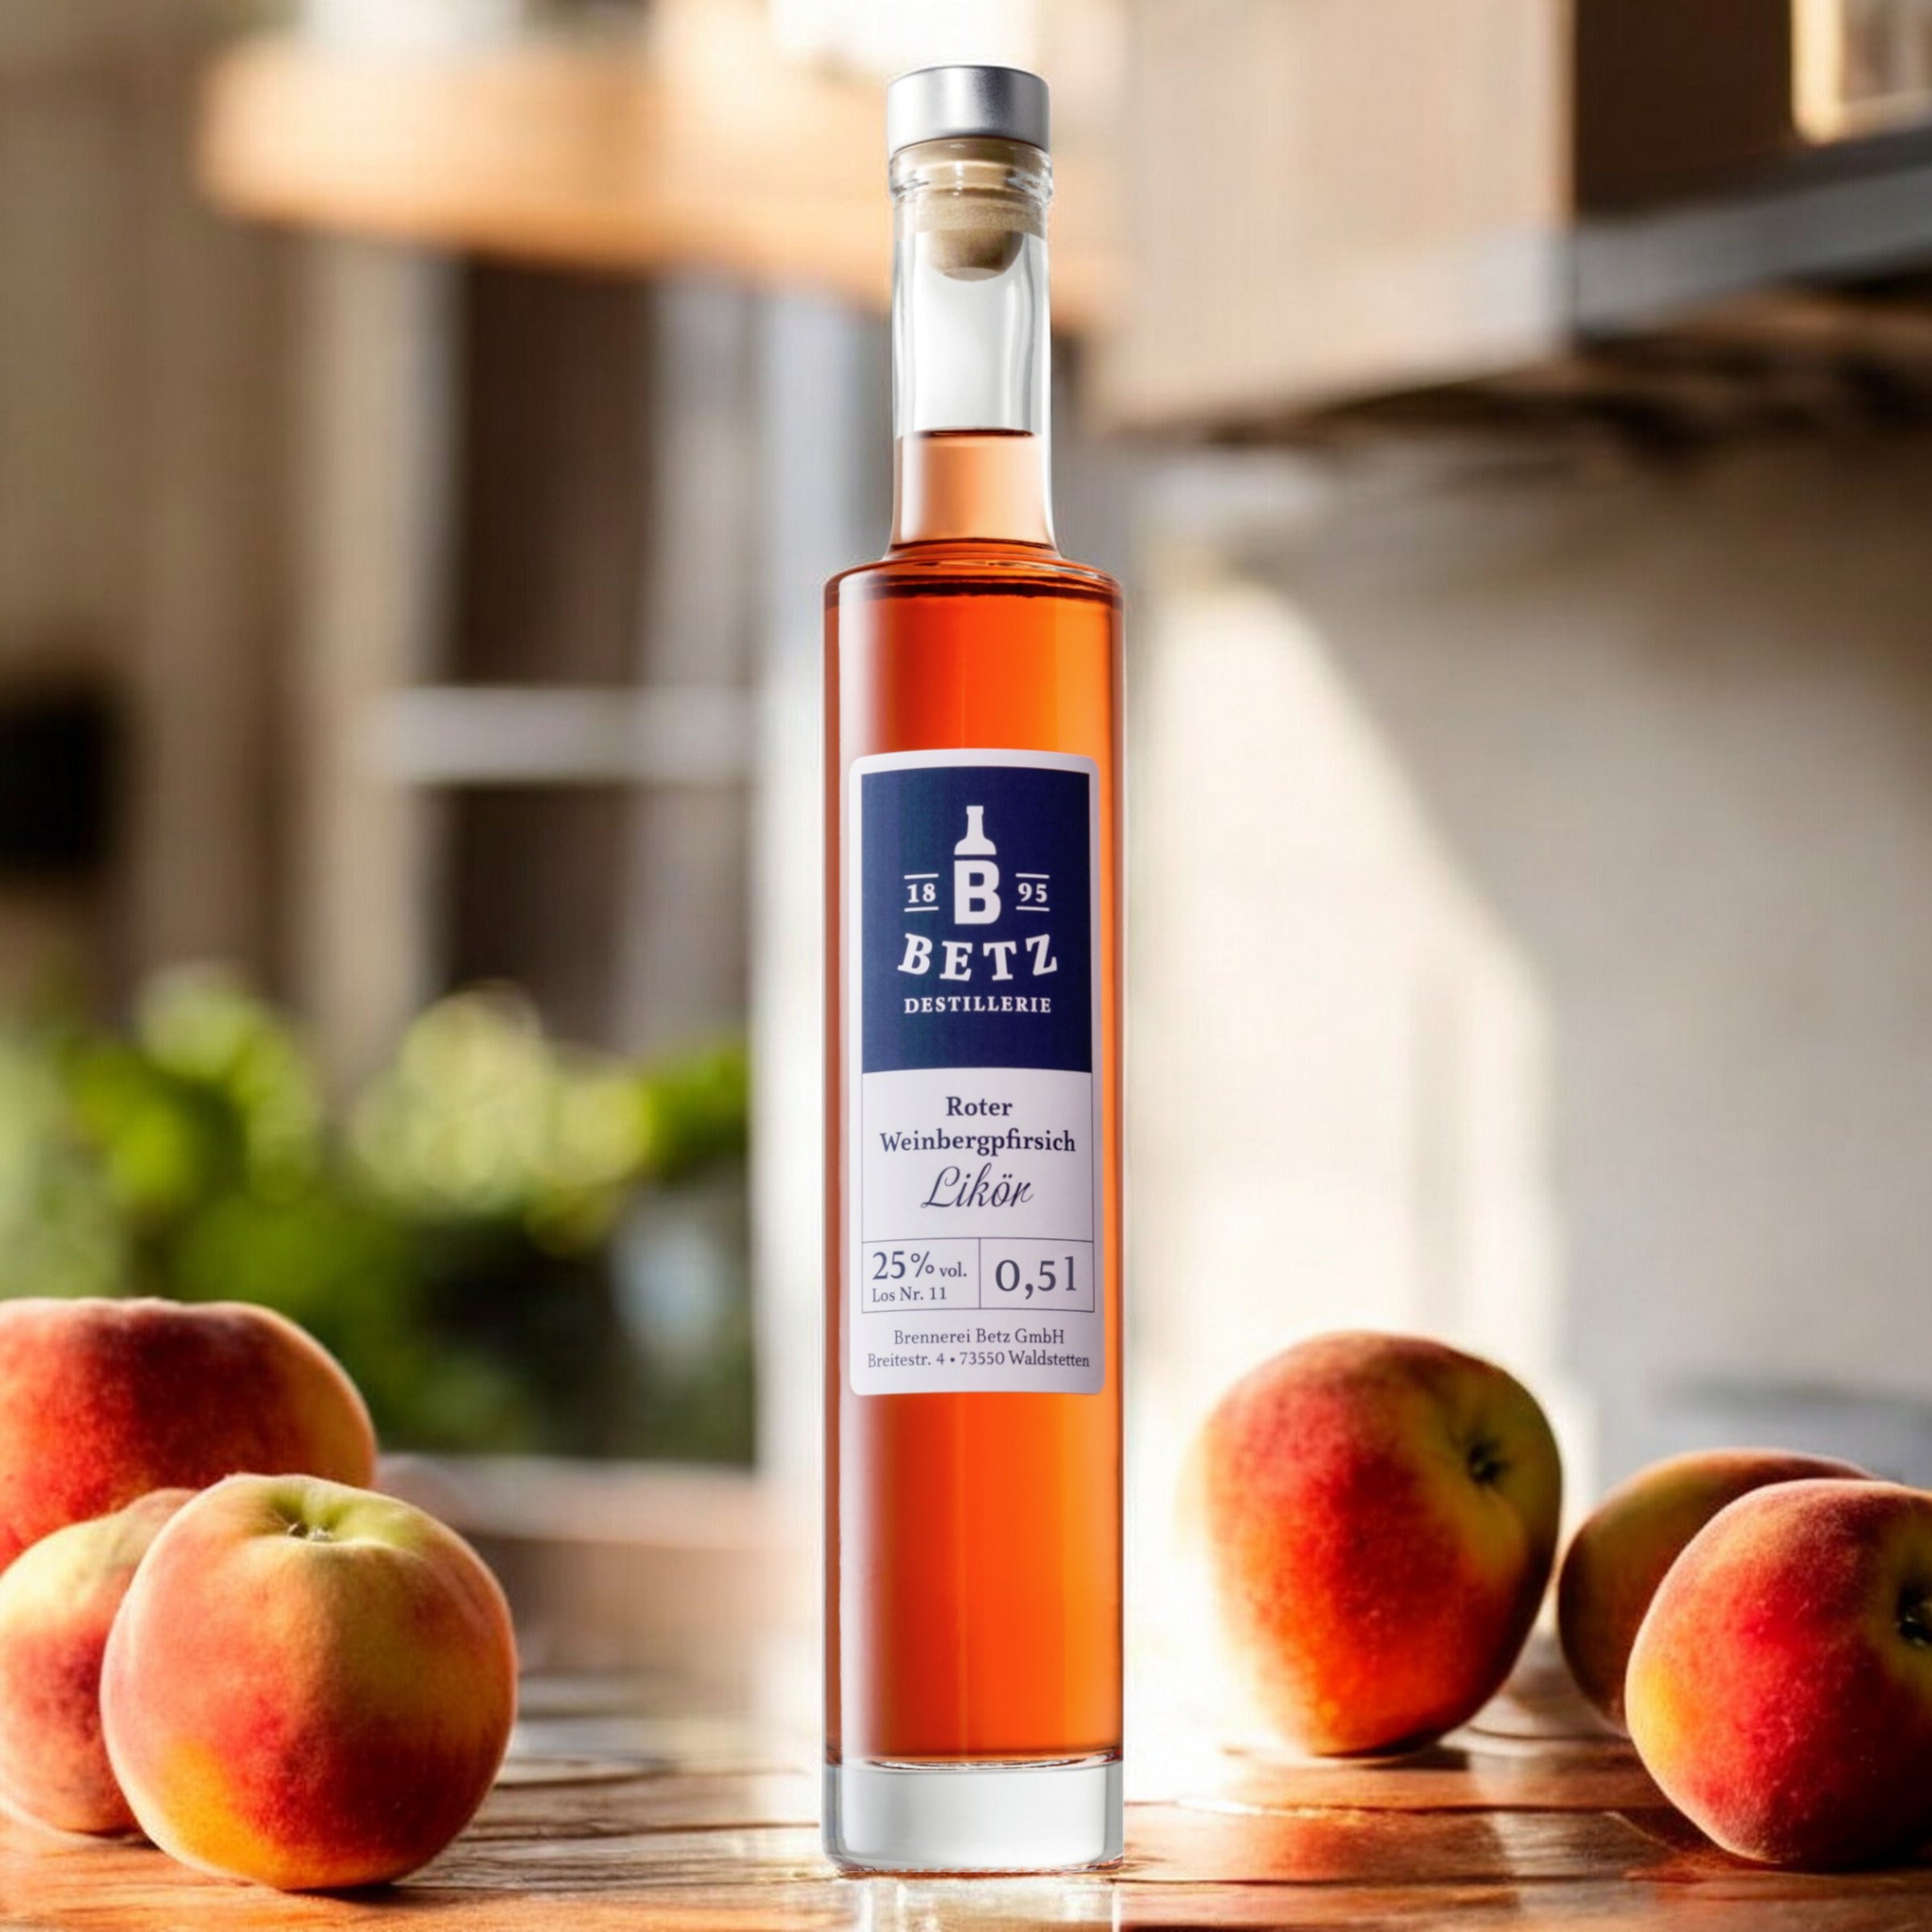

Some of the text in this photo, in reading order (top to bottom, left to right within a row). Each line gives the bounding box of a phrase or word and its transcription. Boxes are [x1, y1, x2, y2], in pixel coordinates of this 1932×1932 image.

[907, 883, 936, 902] 18
[1018, 883, 1048, 902] 95
[898, 933, 1057, 981] BETZ
[904, 997, 1051, 1013] DESTILLERIE
[946, 1096, 1013, 1116] Roter
[880, 1128, 1075, 1156] Weinbergpfirsich
[921, 1162, 1034, 1208] Likör
[872, 1251, 967, 1280] 25% vol.
[872, 1287, 947, 1302] Los Nr. 11
[894, 1328, 1064, 1344] Brennerei Betz GmbH
[868, 1351, 1089, 1368] Breitestr. 4 73550 Waldstetten
